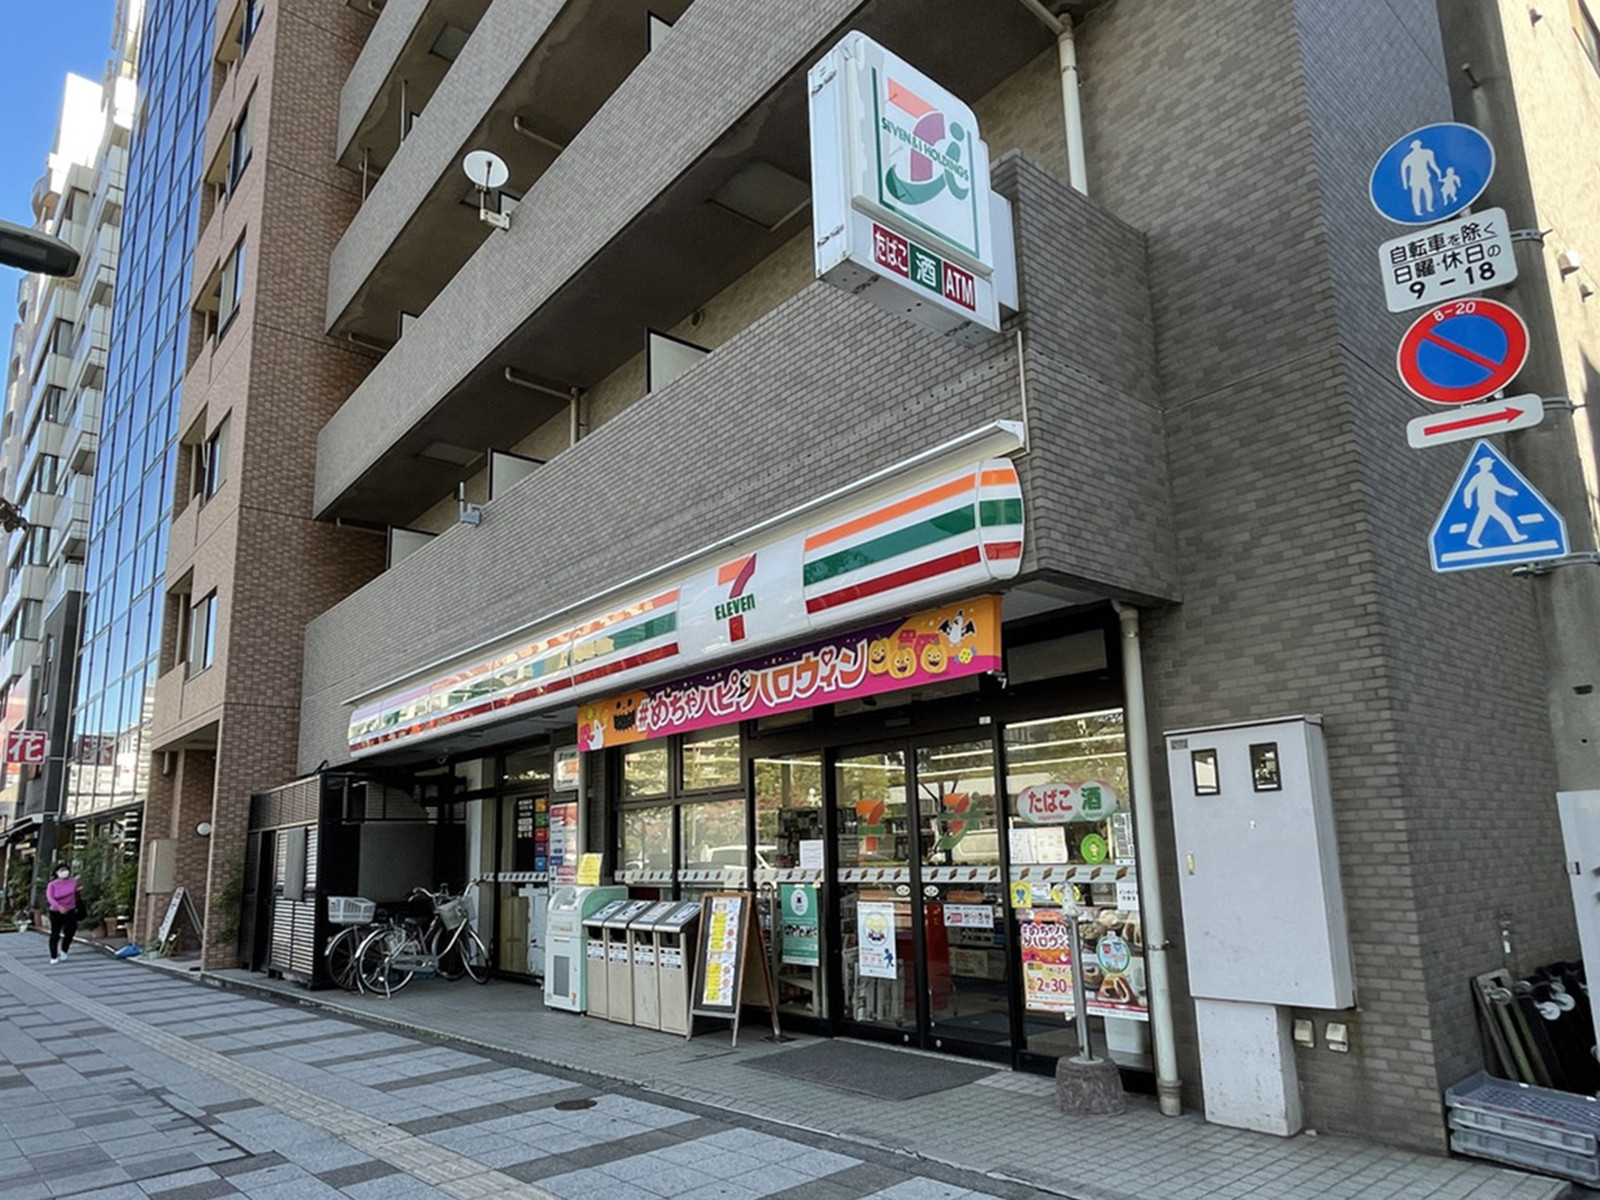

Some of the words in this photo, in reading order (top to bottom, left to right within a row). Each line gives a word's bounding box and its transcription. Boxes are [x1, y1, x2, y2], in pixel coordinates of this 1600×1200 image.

[873, 231, 909, 273] たばこ
[1389, 221, 1497, 264] 自転車を除く
[915, 251, 937, 288] 酒
[1393, 244, 1501, 285] 日曜・休日の
[945, 269, 975, 309] ATM
[1432, 301, 1477, 322] 8-20
[8, 733, 45, 762] 花
[1028, 789, 1073, 814] たばこ
[1081, 786, 1102, 811] 酒
